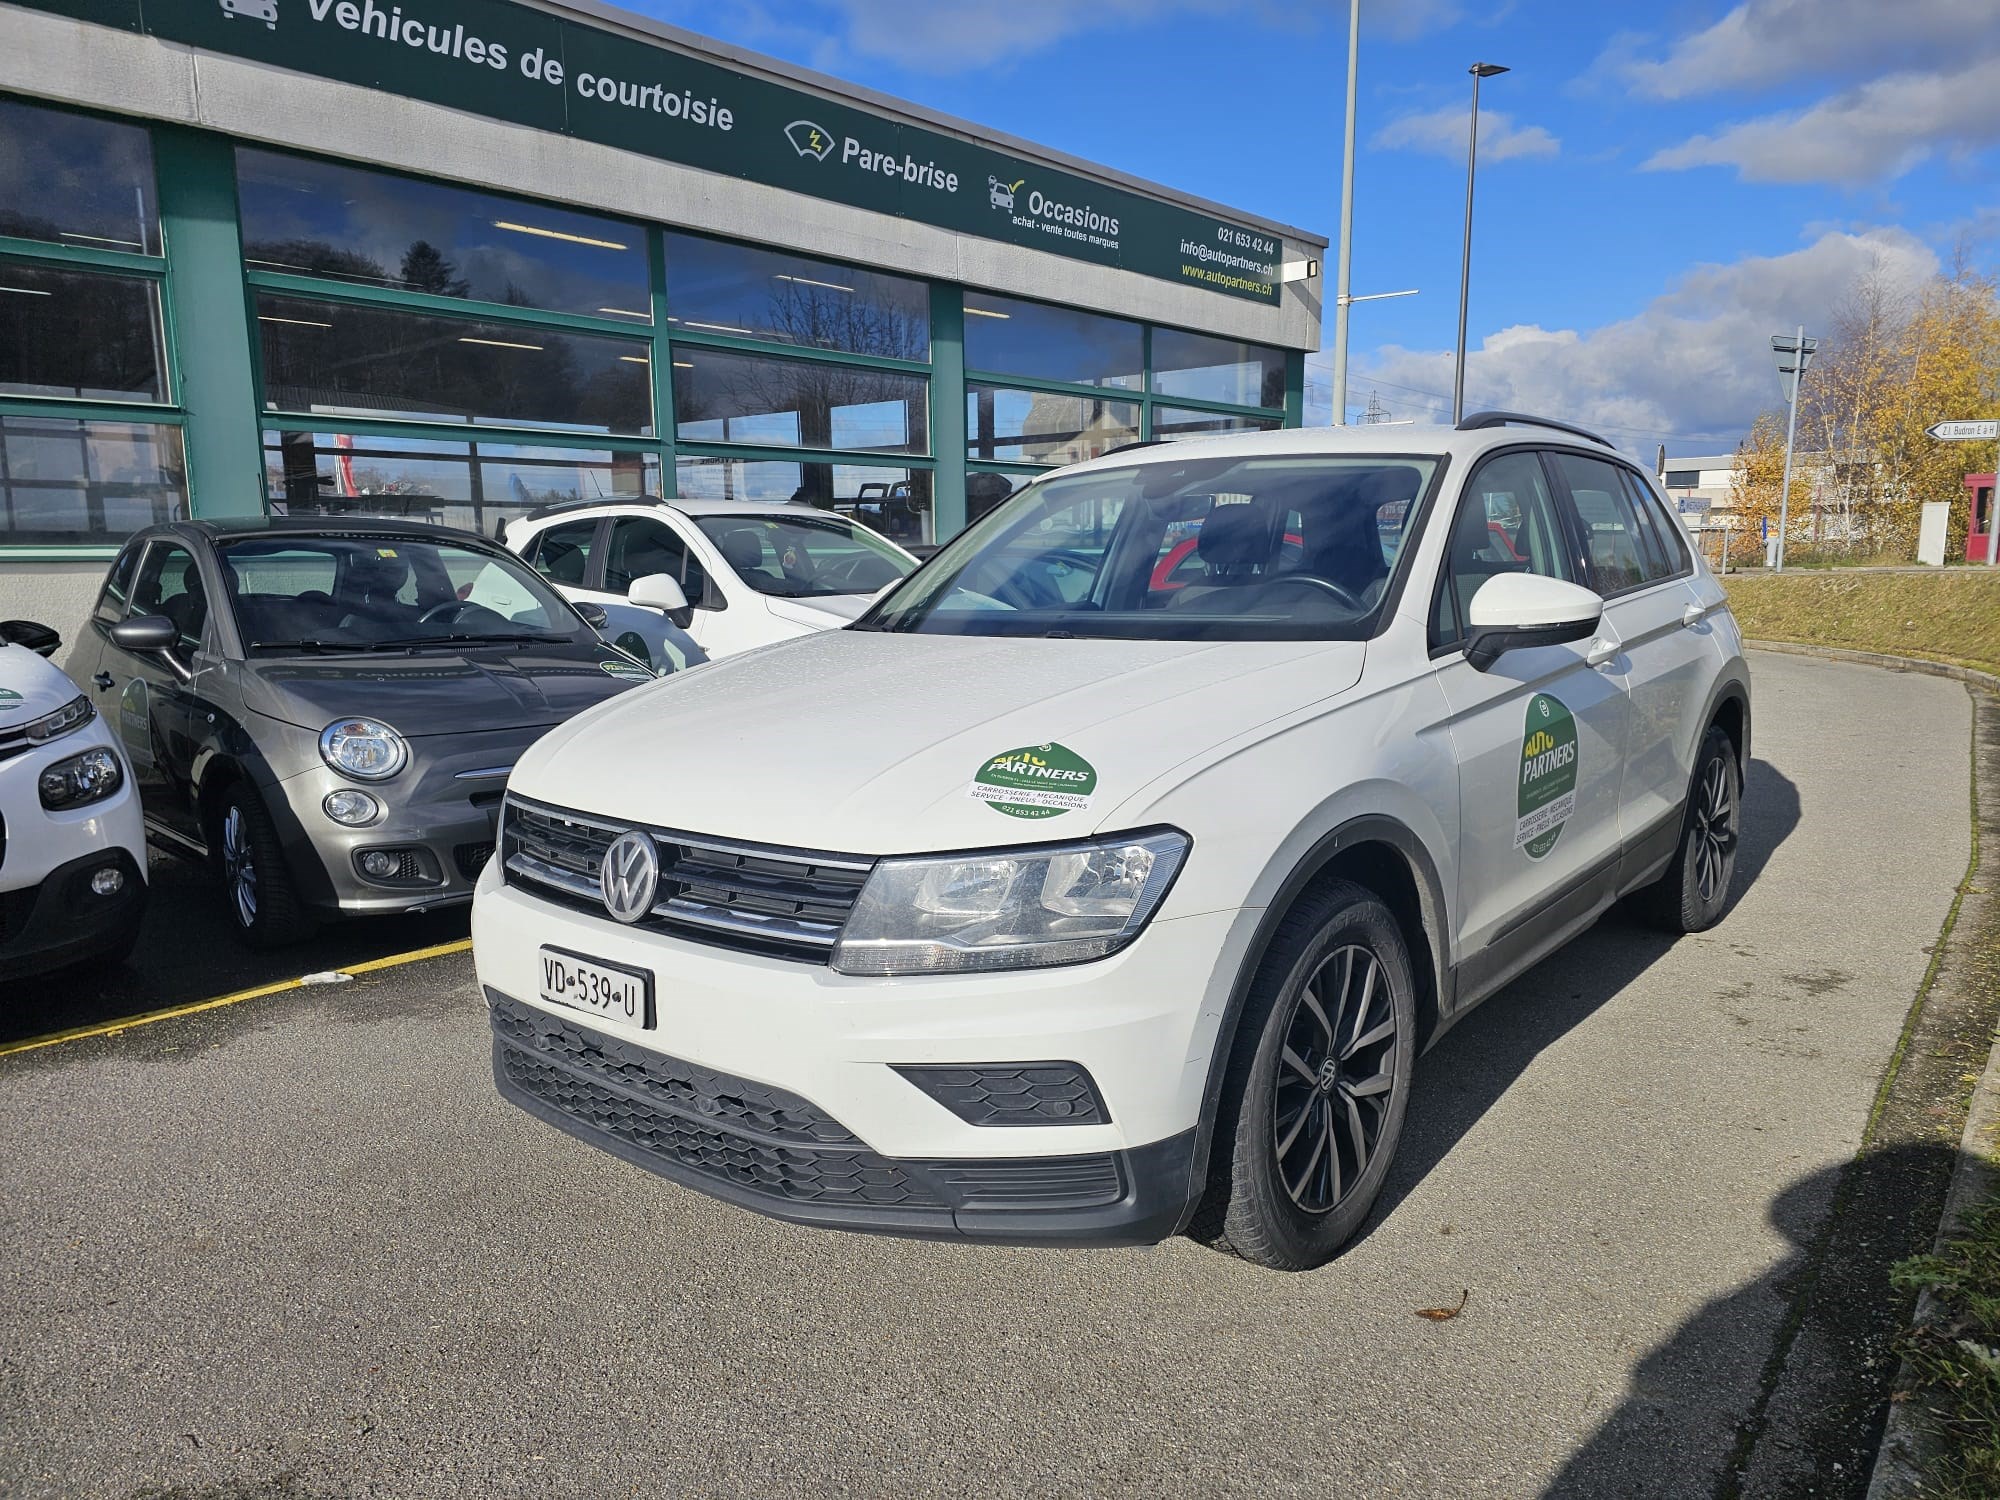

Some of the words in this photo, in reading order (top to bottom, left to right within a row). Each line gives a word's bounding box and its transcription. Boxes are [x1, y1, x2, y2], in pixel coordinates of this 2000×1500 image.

[520, 47, 564, 85] de
[577, 72, 734, 132] courtoisie
[842, 137, 959, 193] Pare-brise
[1028, 191, 1119, 236] Occasions
[1012, 215, 1035, 229] achat
[1041, 222, 1063, 236] vente
[1064, 227, 1087, 242] toutes
[1088, 234, 1119, 249] marques
[1218, 226, 1233, 243] 021
[1235, 232, 1251, 249] 653
[1251, 237, 1262, 252] 42
[1263, 242, 1274, 255] 44
[1180, 239, 1273, 277] info@autopartners.ch
[1182, 264, 1273, 296] www.autopartners.ch
[987, 760, 1090, 782] PARTNERS
[1523, 740, 1575, 785] PARTNERS
[970, 791, 1004, 802] SERVICE
[1009, 795, 1036, 804] PNEUS
[1041, 799, 1088, 810] OCCASIONS
[977, 785, 1032, 798] CARROSSERIE
[543, 957, 566, 994] VD
[577, 967, 611, 1009] 539
[624, 983, 635, 1018] U
